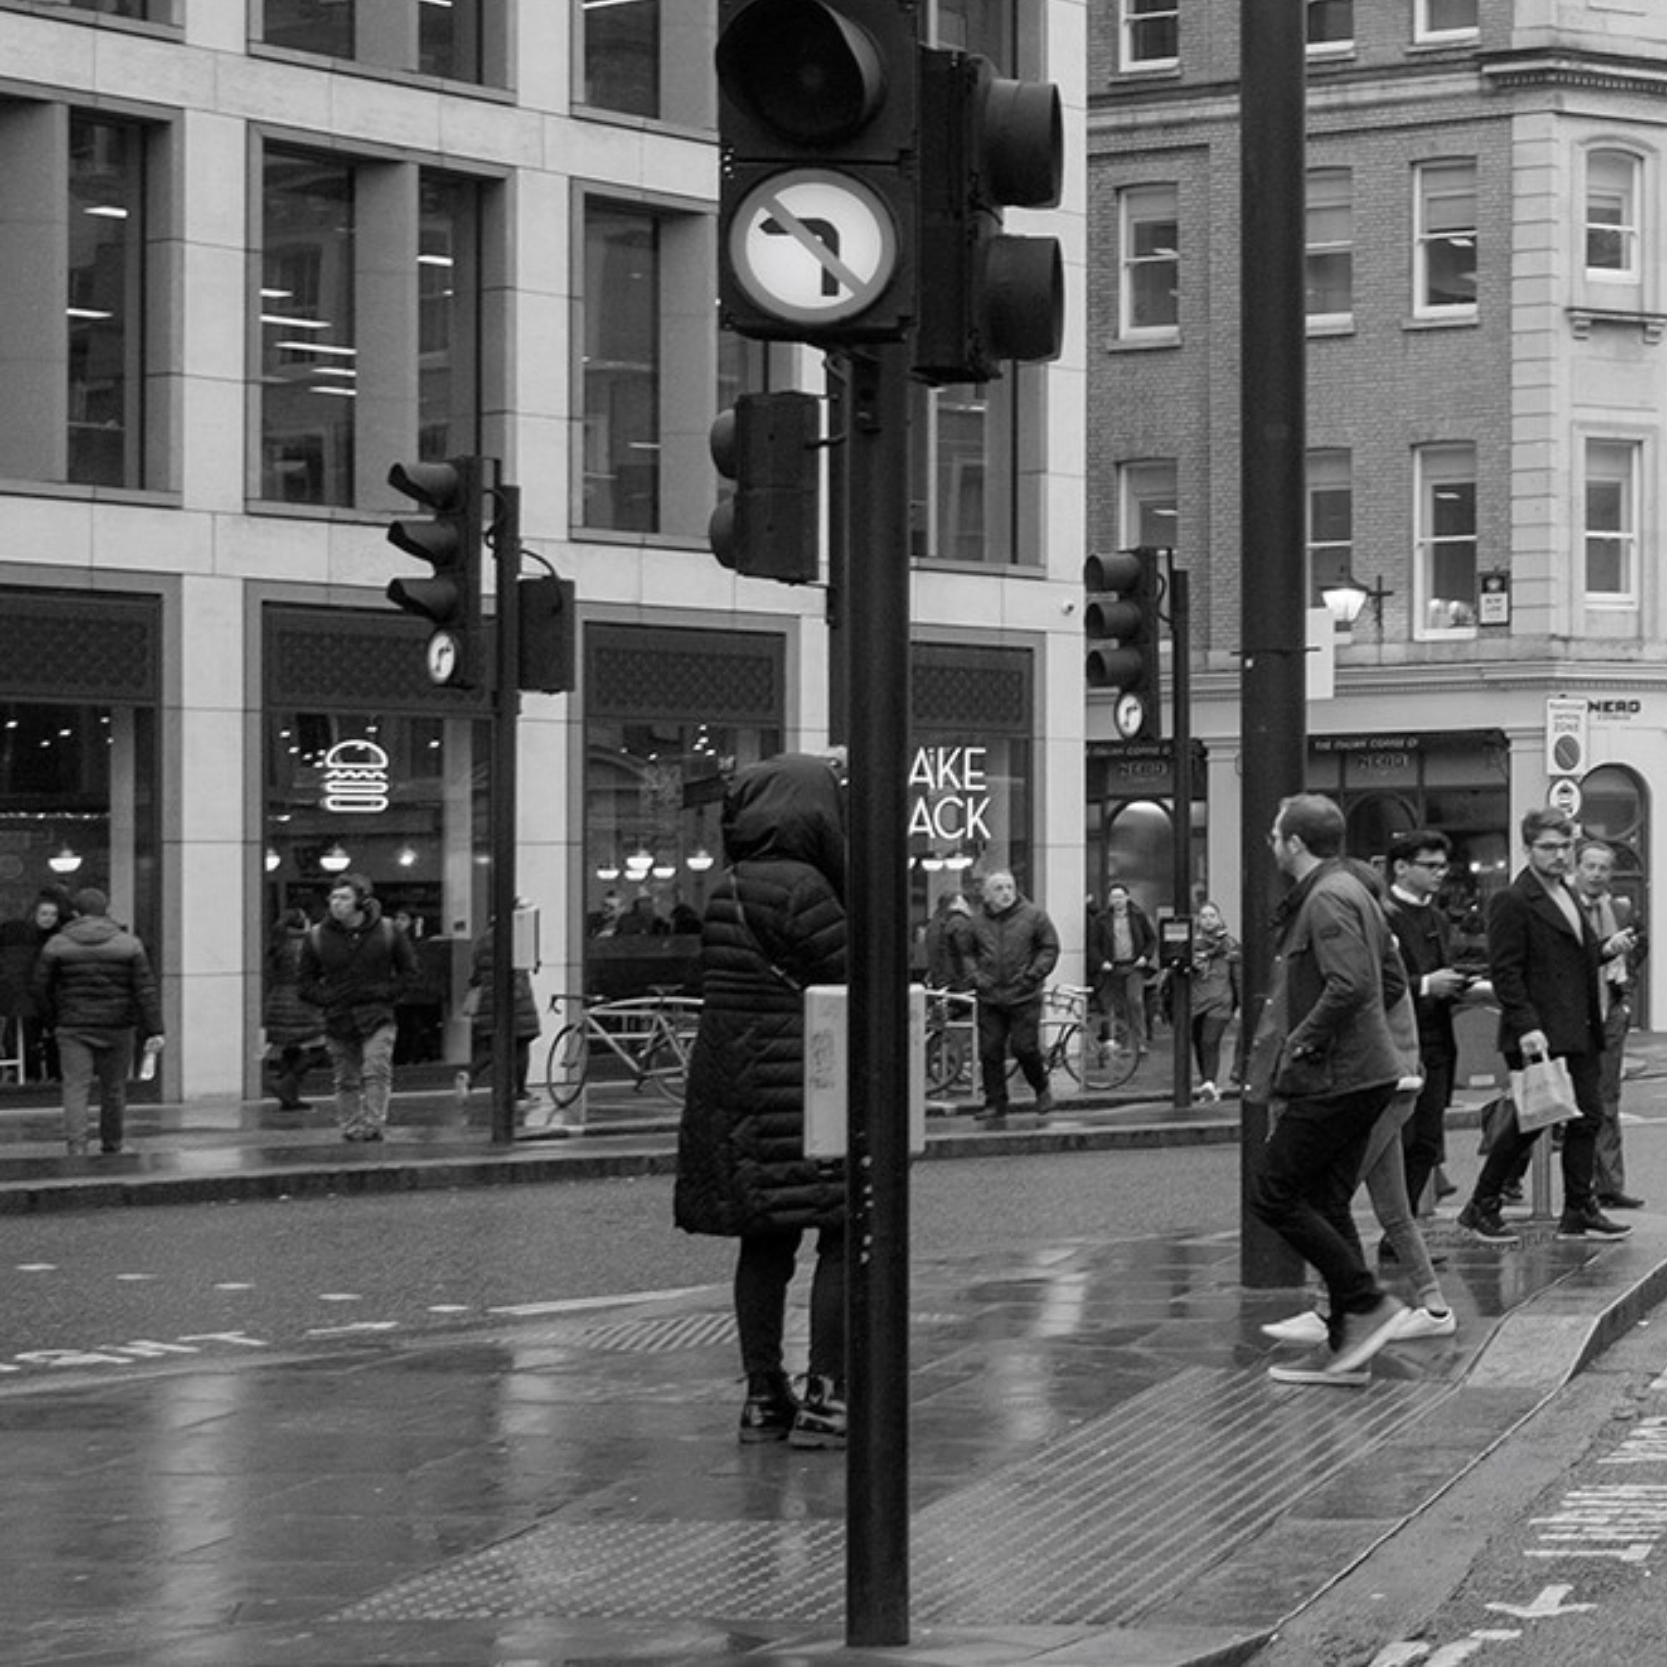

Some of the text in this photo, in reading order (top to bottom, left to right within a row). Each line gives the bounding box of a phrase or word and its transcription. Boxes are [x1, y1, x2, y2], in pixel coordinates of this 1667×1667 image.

[1587, 700, 1641, 713] NERO
[908, 746, 987, 790] AKE
[908, 796, 991, 839] ACK
